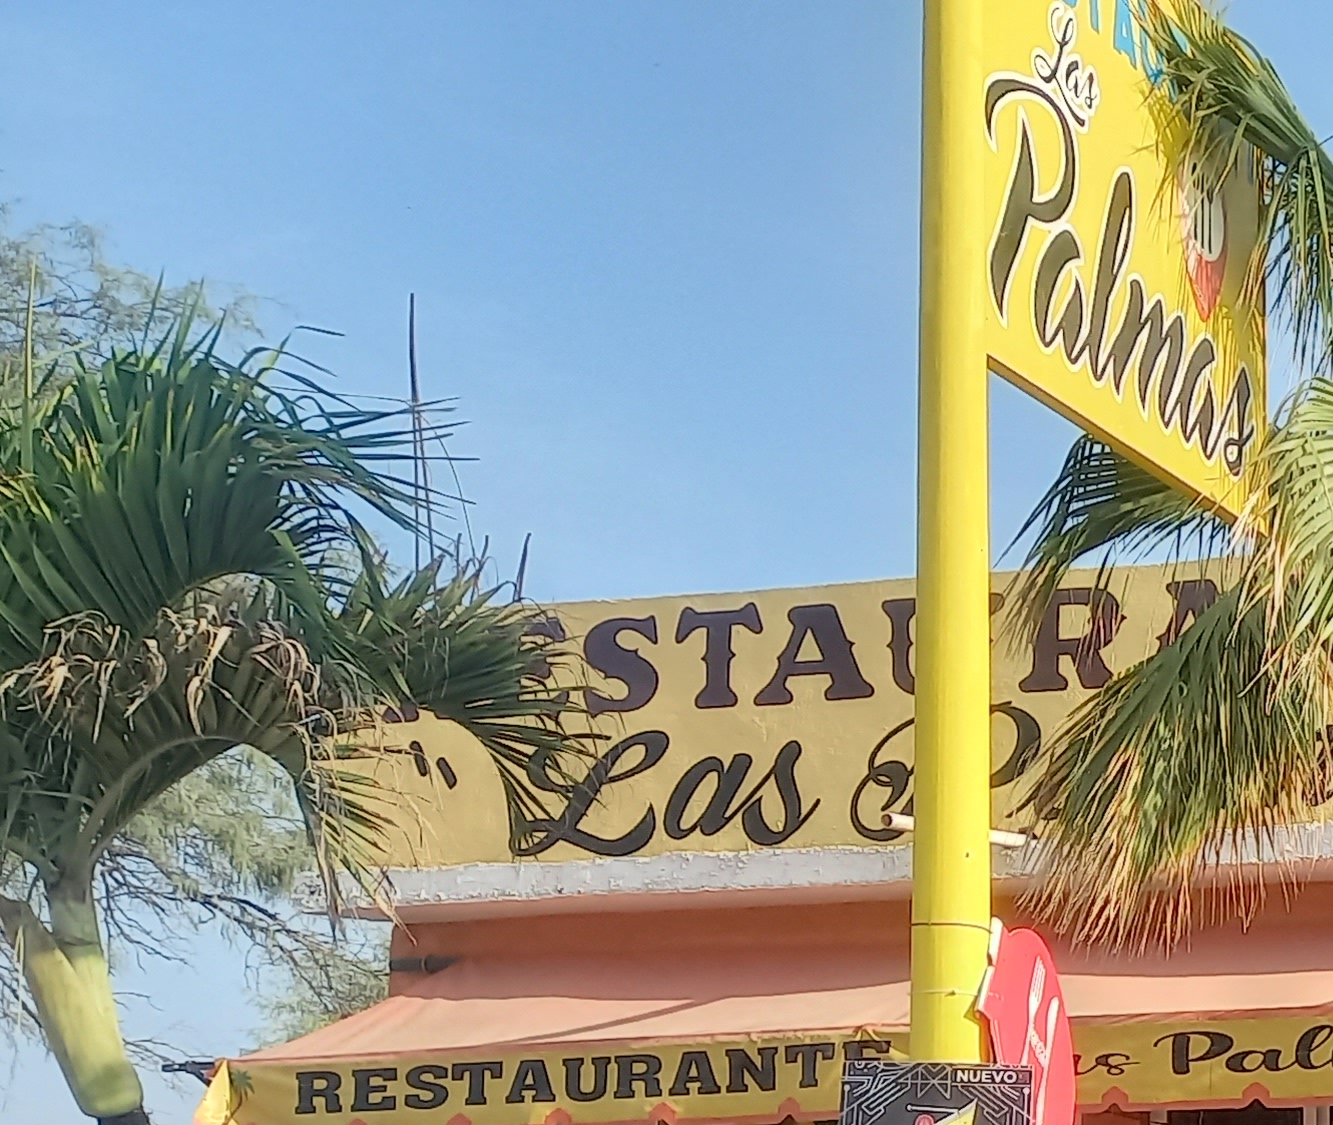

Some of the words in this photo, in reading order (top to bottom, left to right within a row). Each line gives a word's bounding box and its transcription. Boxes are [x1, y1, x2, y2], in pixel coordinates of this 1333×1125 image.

[1035, 4, 1097, 127] Las
[985, 79, 1255, 476] Palmas
[956, 1070, 1018, 1084] NUEVO
